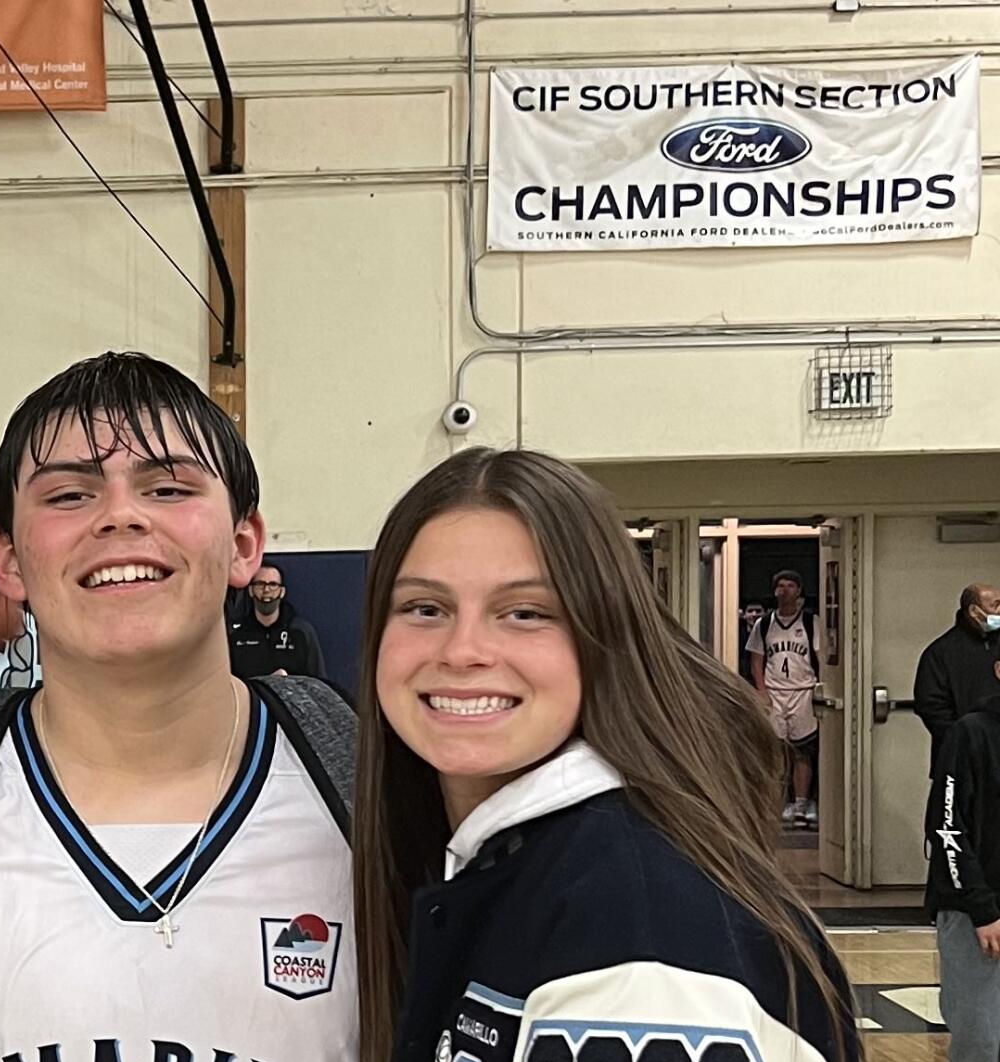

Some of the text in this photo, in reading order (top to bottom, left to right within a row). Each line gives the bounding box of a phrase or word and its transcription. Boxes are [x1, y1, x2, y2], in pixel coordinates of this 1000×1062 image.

[42, 61, 86, 73] Hospital
[53, 78, 88, 90] Center
[512, 73, 957, 112] CIF SOUTHERN SECTION
[690, 126, 782, 163] Ford
[514, 174, 957, 222] CHAMPIONSHIPS
[517, 230, 594, 241] SOUTHERN
[597, 227, 686, 240] CALIFORNIA
[690, 226, 728, 237] FORD
[732, 226, 796, 236] DEALER
[829, 371, 876, 404] EXIT
[781, 656, 790, 679] 4
[273, 955, 326, 969] COASTAL
[273, 966, 326, 979] CANYON
